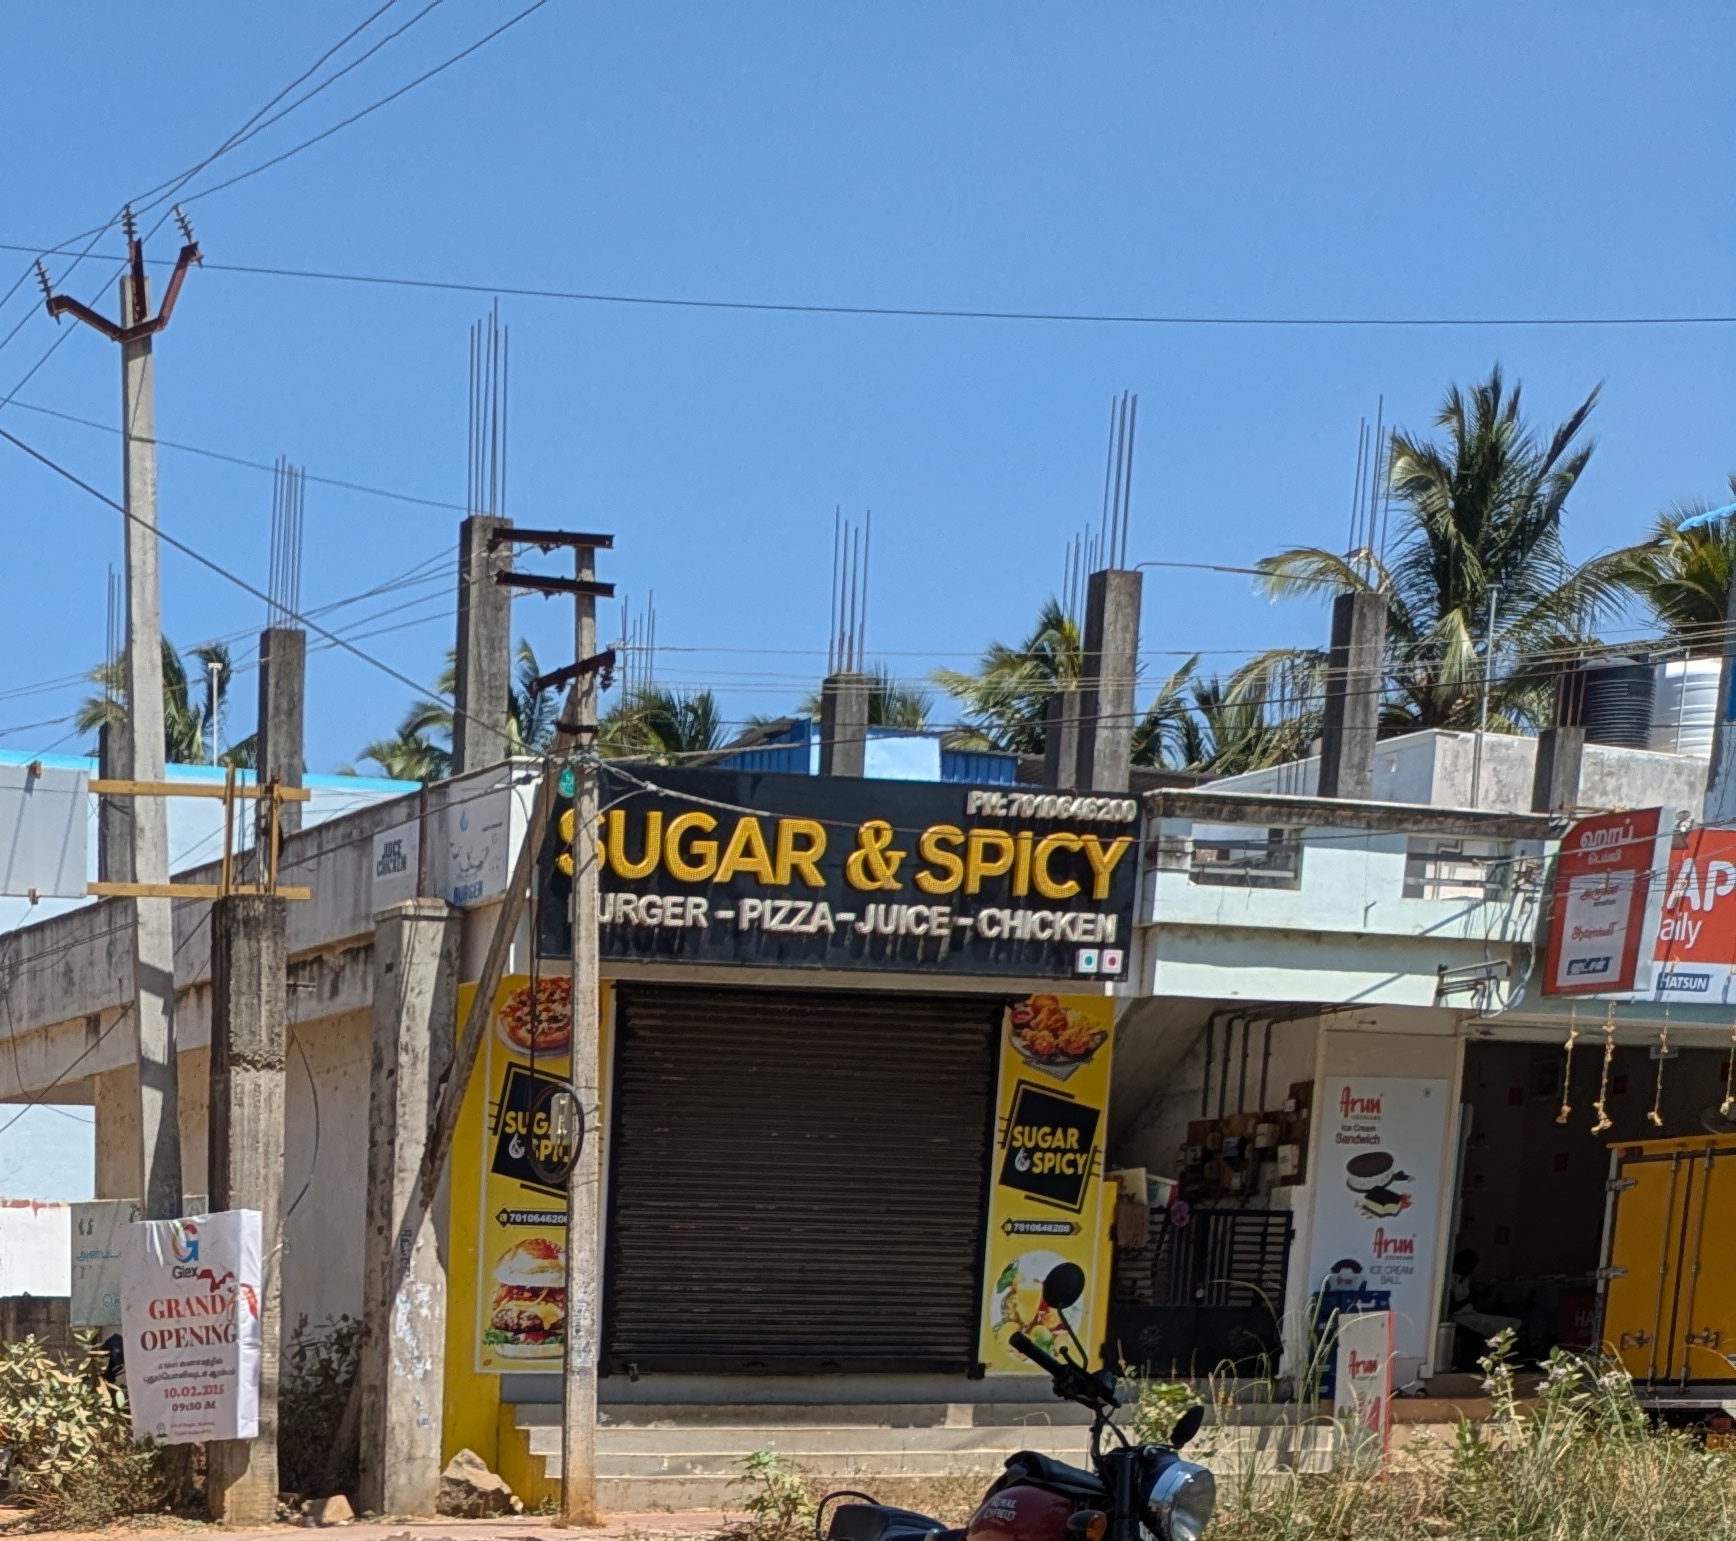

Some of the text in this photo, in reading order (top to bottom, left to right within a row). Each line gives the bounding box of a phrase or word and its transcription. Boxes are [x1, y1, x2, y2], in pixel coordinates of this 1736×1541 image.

[557, 808, 1134, 900] SUGAR & SPICY
[568, 892, 709, 928] URGER
[977, 907, 1119, 943] CHICKEN
[1340, 1085, 1381, 1118] Arun
[1012, 1125, 1080, 1149] SUGAR
[1335, 1132, 1381, 1145] Sandwich
[1032, 1151, 1088, 1175] SPICY
[1372, 1226, 1414, 1259] Arun
[148, 1293, 226, 1320] GRAND
[140, 1322, 238, 1351] OPENING
